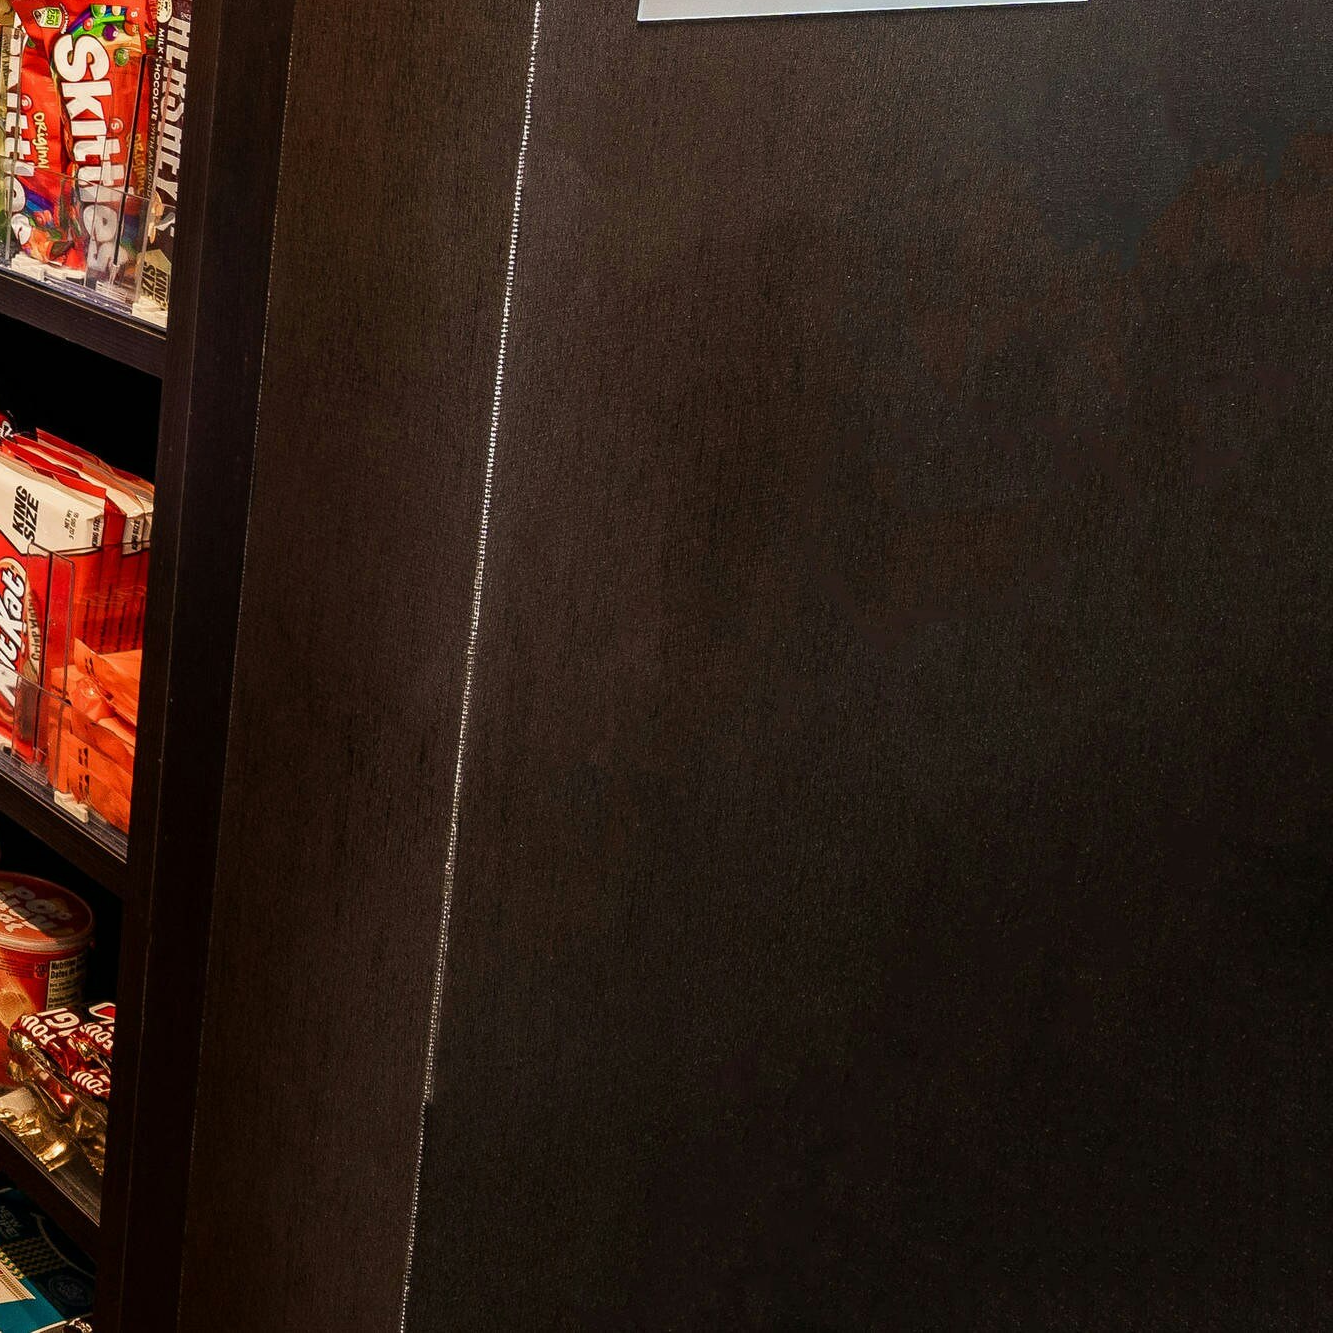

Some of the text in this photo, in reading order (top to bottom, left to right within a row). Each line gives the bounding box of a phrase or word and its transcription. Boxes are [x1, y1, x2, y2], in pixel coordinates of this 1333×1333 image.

[45, 7, 55, 26] 250
[156, 27, 166, 50] MILK
[33, 111, 50, 170] Original
[53, 34, 131, 273] Skittles
[142, 260, 156, 297] SIZE
[11, 484, 30, 535] KING
[23, 492, 40, 543] SIZE
